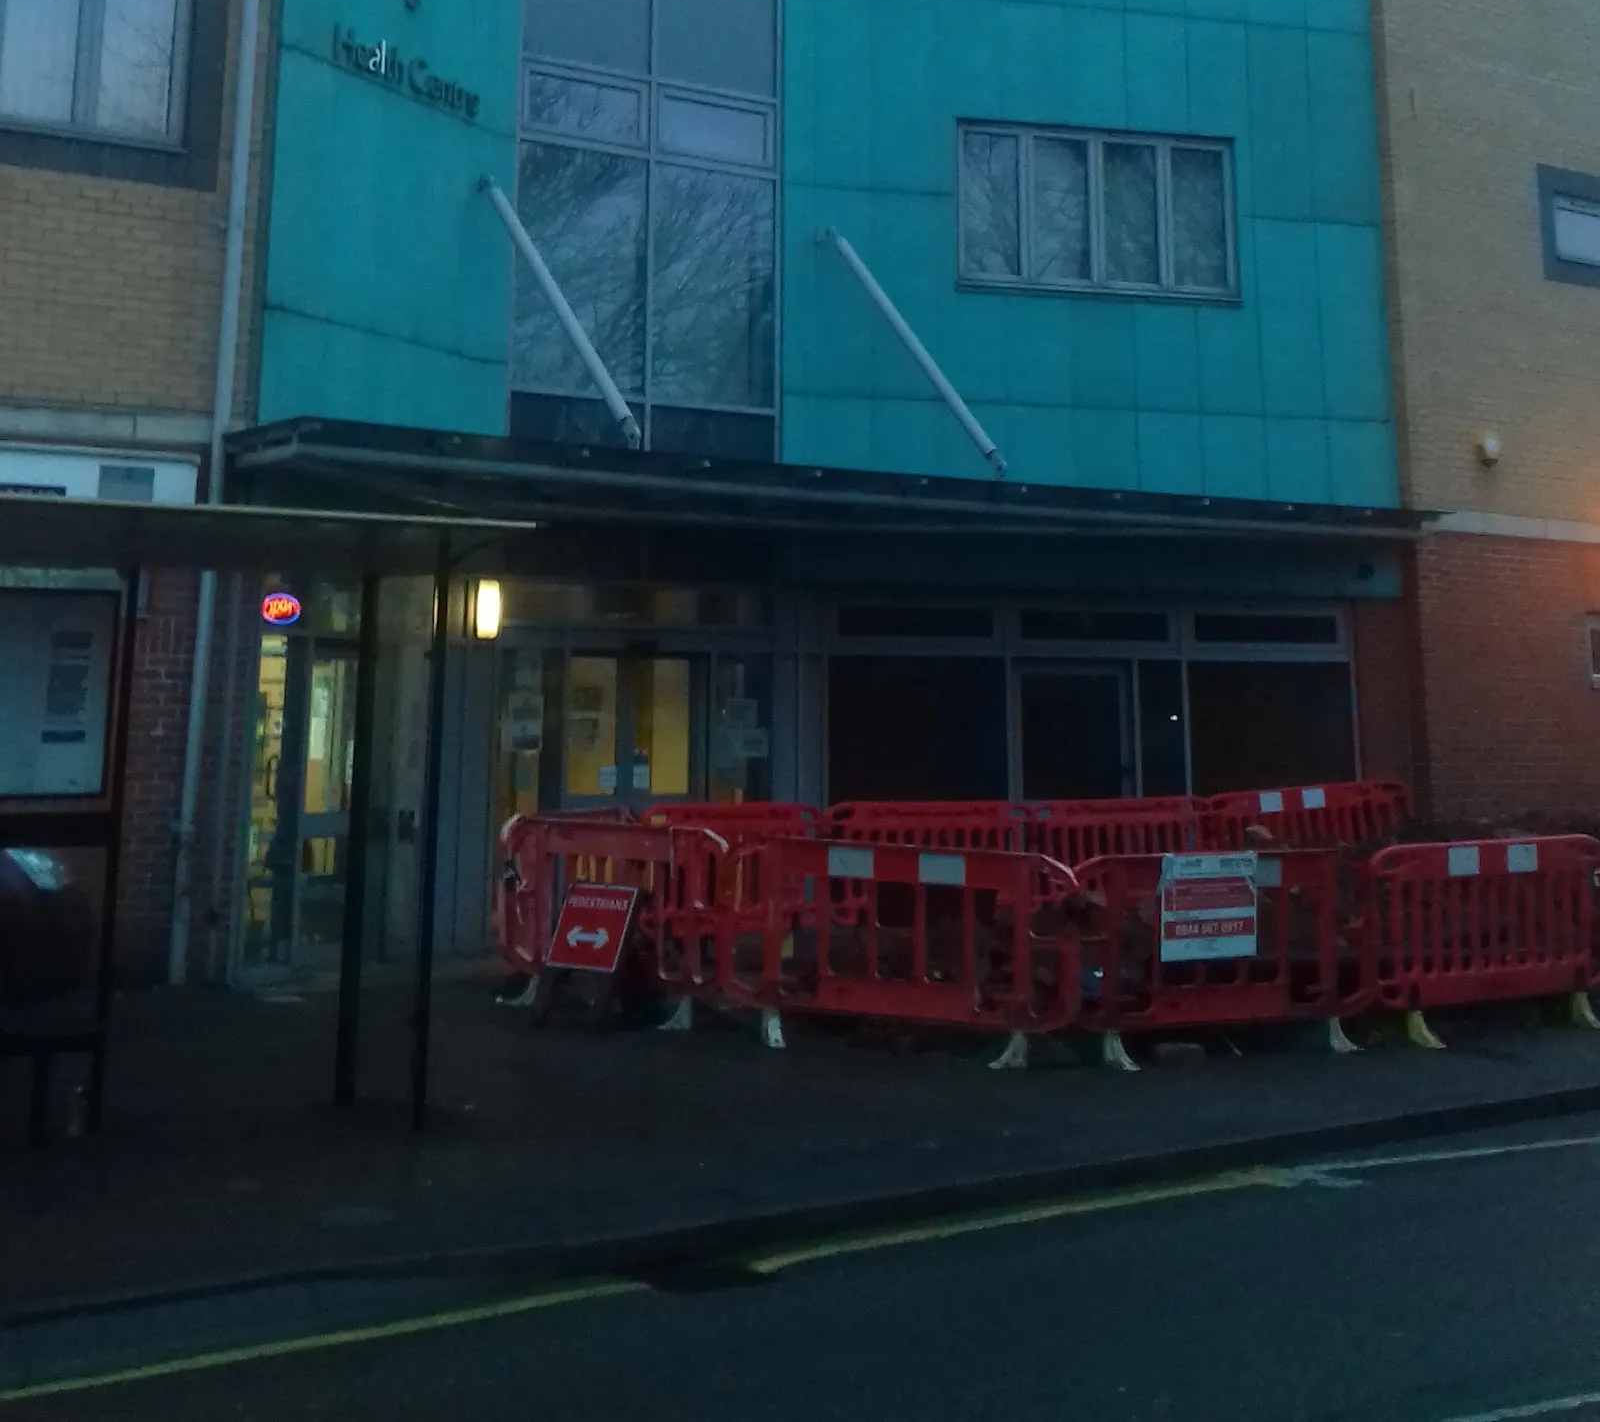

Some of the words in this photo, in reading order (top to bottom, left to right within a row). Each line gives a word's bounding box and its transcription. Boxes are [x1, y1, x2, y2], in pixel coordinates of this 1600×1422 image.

[331, 21, 405, 88] Health
[407, 55, 481, 119] Centre
[566, 895, 629, 911] PEDESTRIANS
